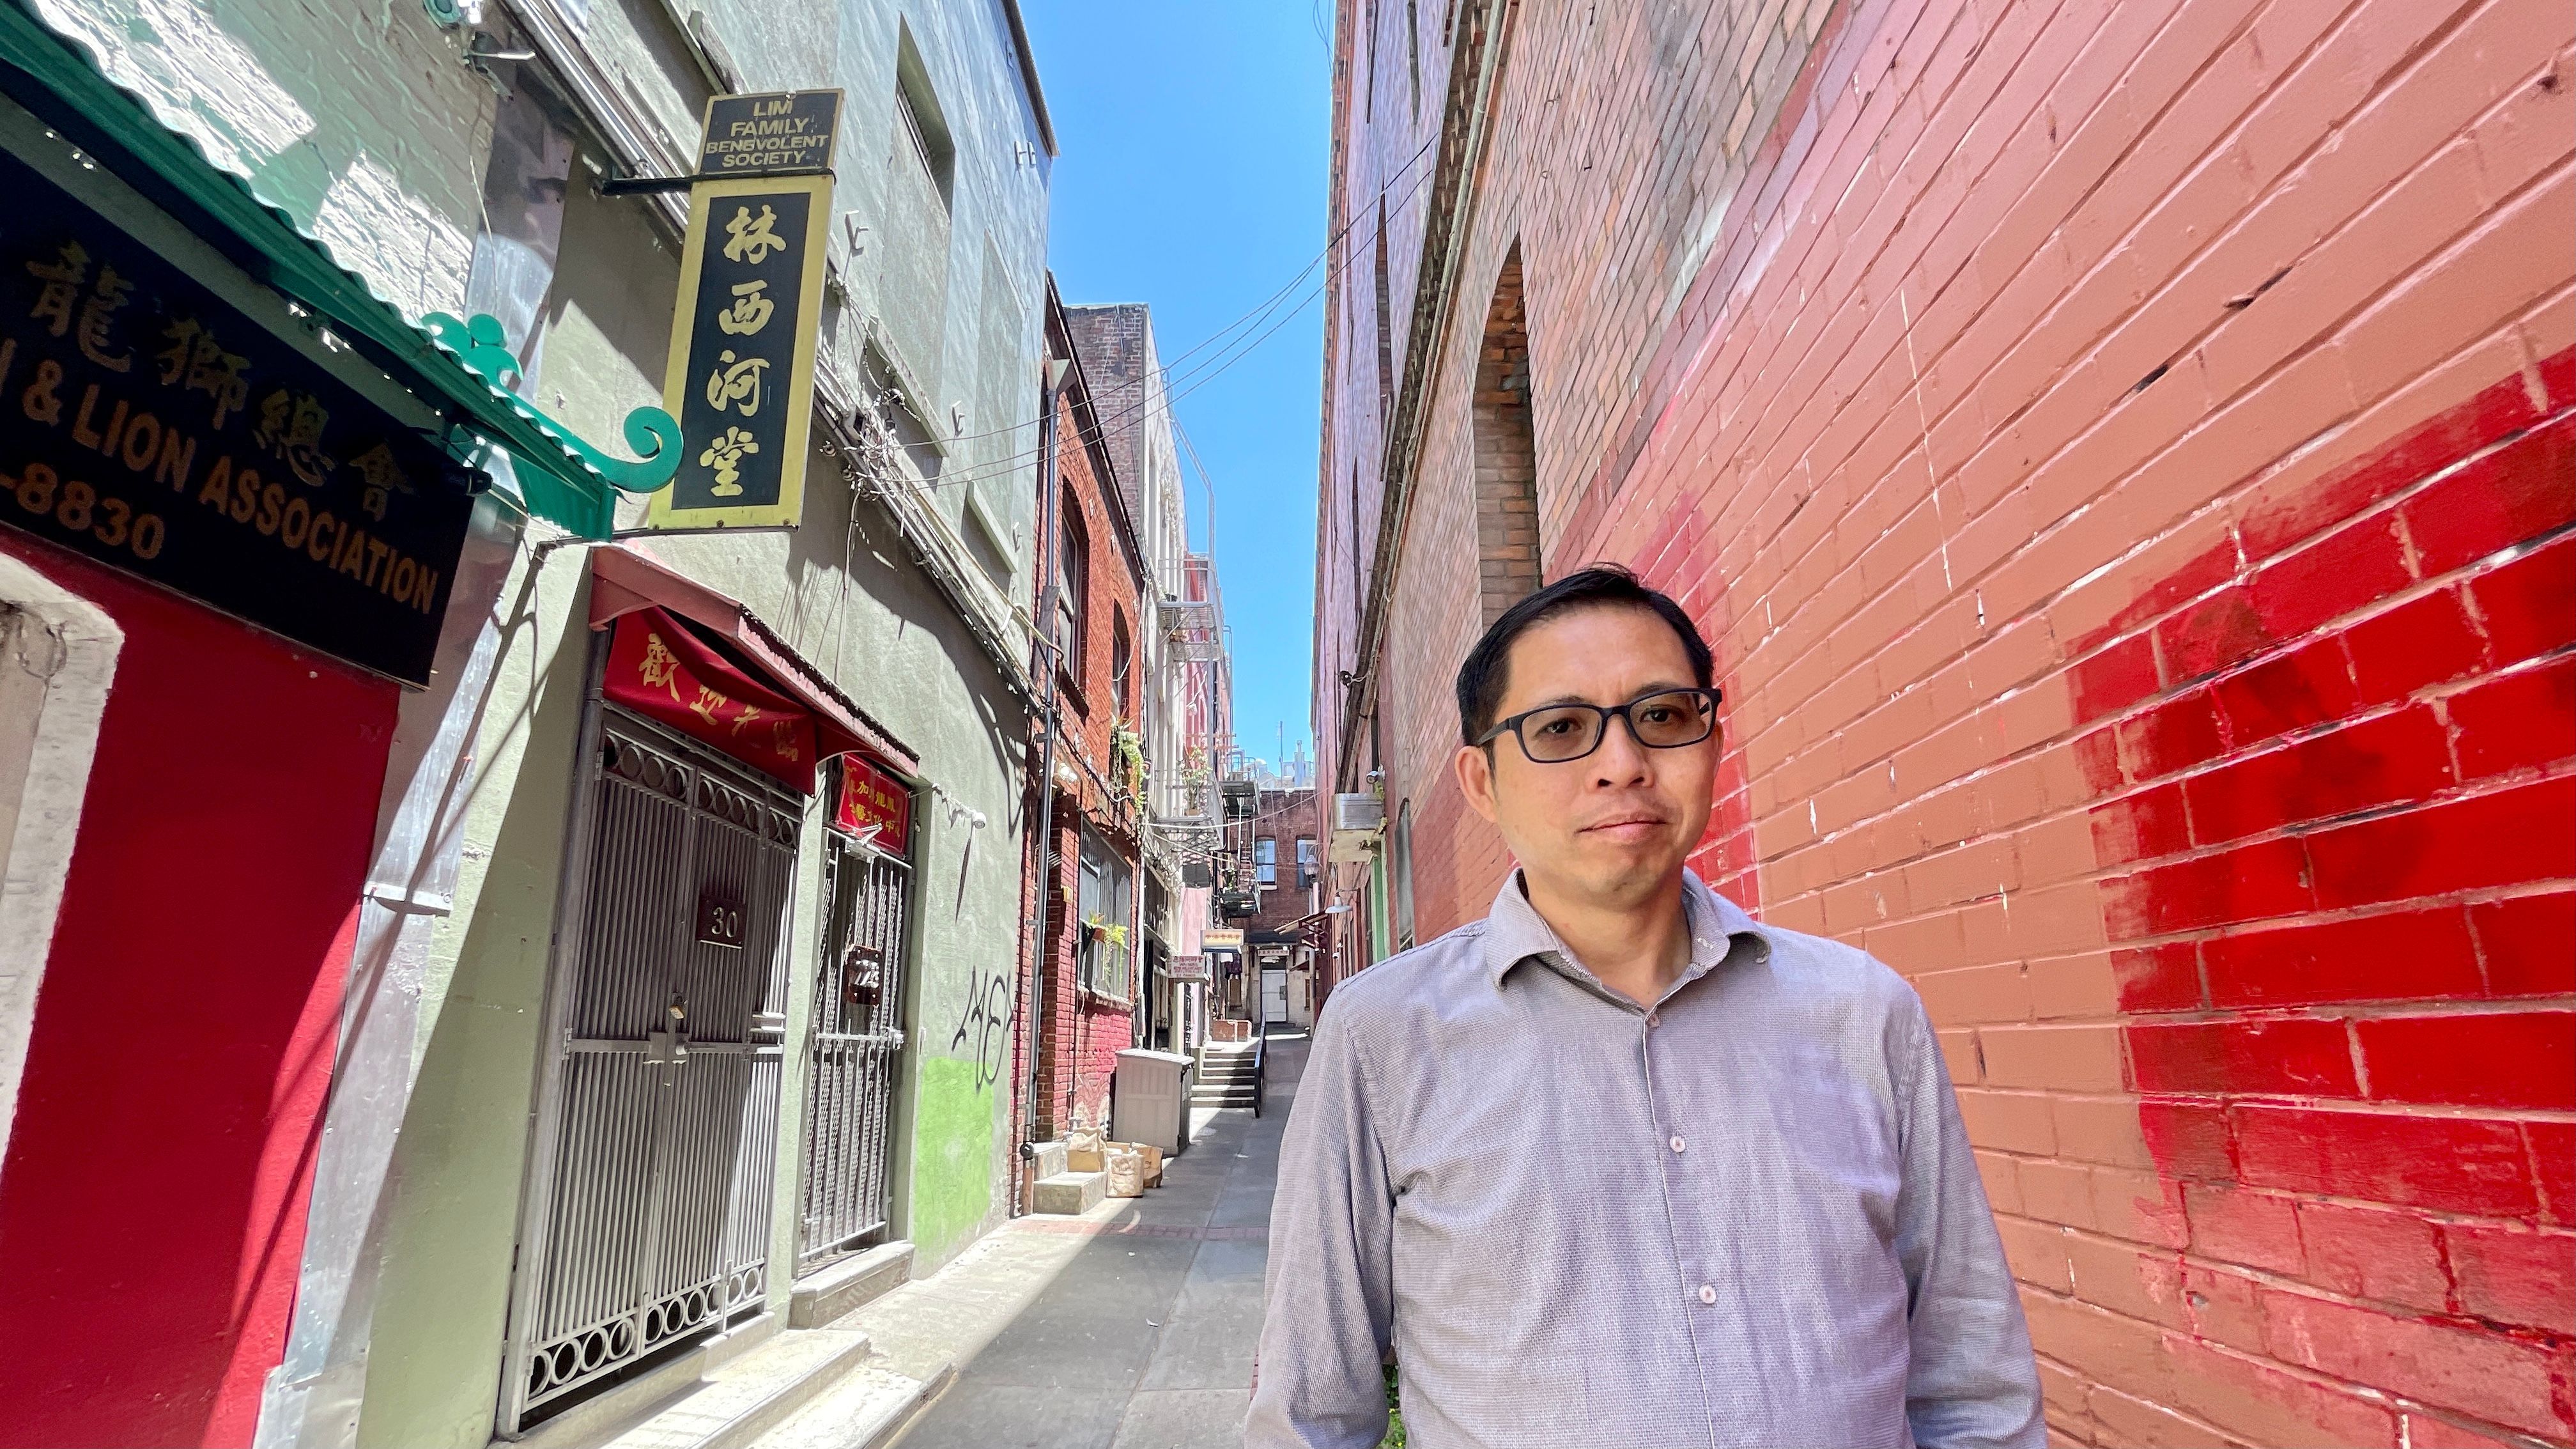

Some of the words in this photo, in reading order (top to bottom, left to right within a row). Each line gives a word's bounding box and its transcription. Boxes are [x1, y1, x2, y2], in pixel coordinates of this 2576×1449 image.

[753, 100, 792, 117] LIM
[730, 118, 808, 137] FAMILY
[706, 135, 828, 154] BENEVOLENT
[722, 150, 806, 167] SOCIETY
[700, 205, 786, 497] 林西河堂
[22, 359, 62, 428] &
[72, 384, 197, 493] LION
[199, 455, 438, 614] ASSOCIATION
[711, 907, 738, 938] 30
